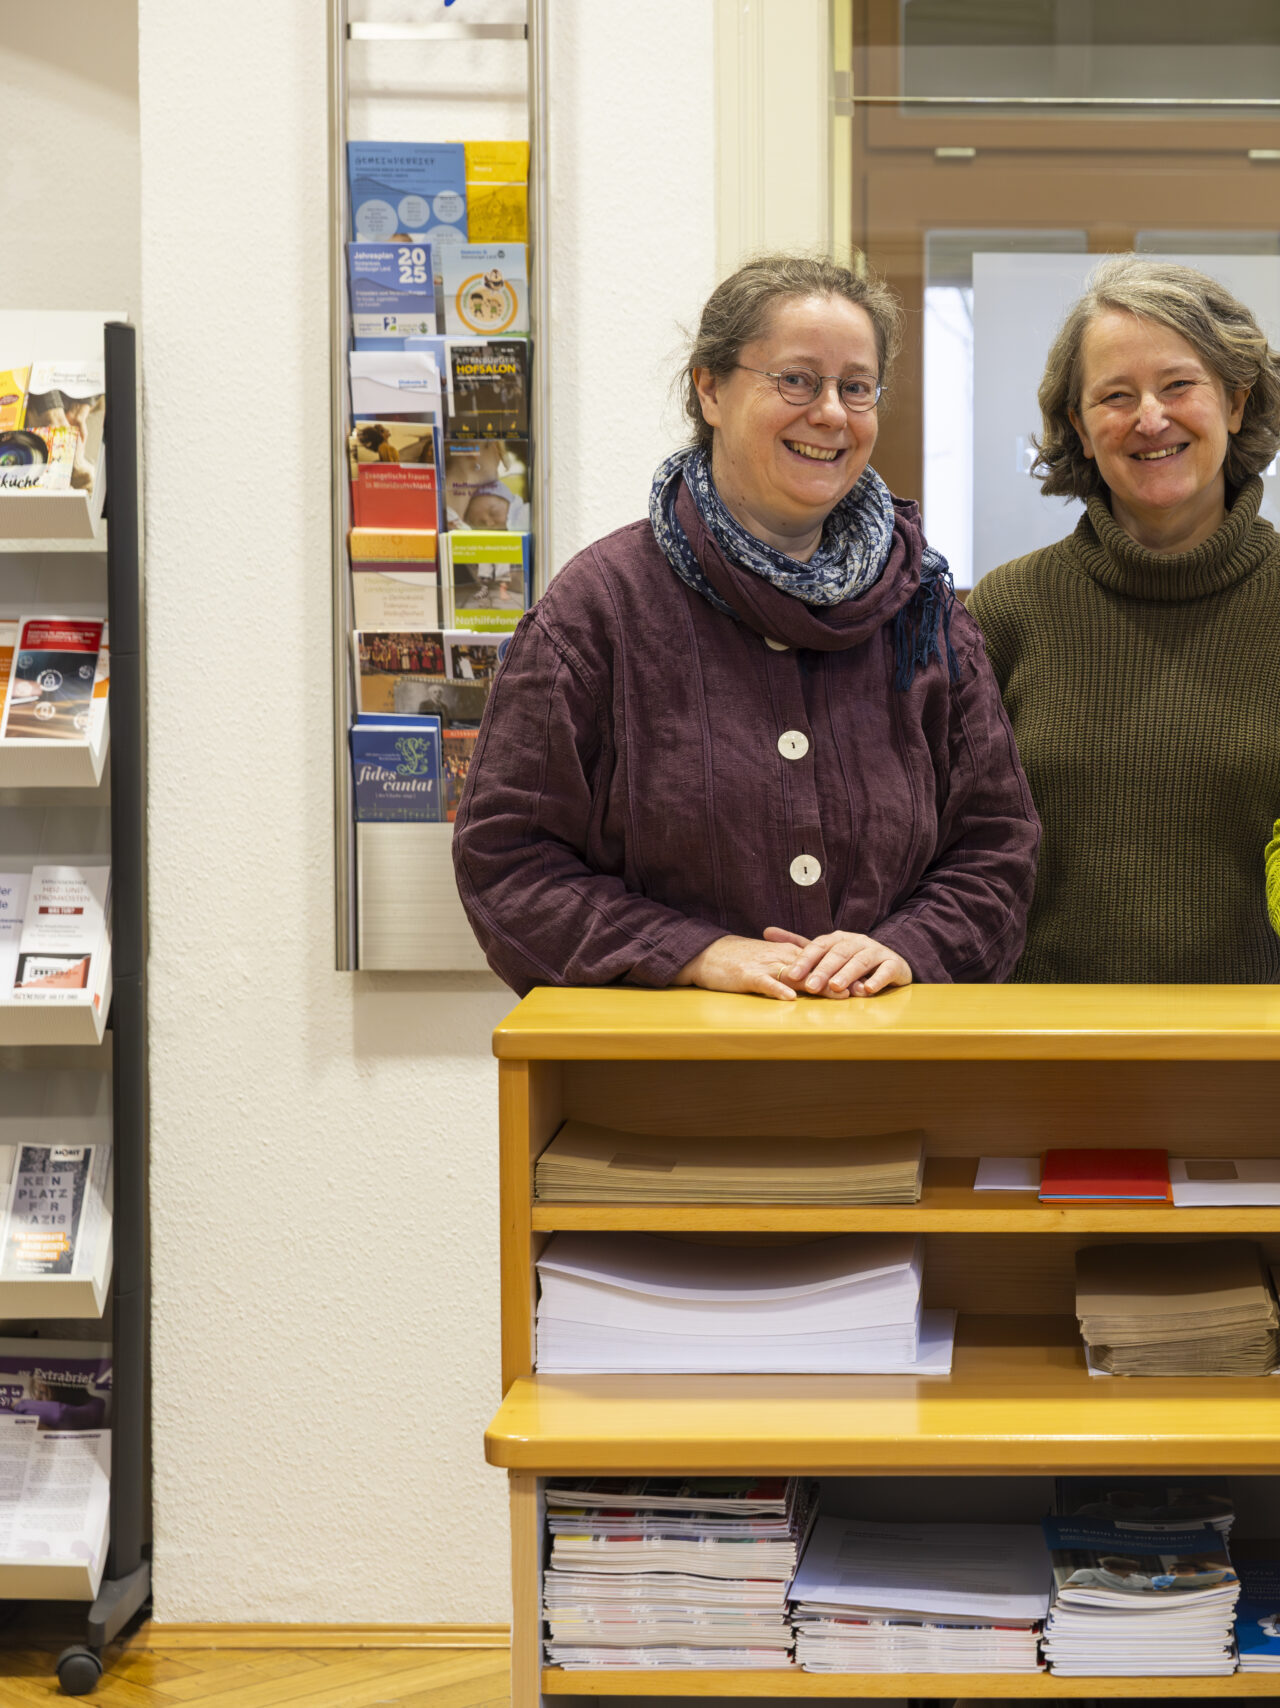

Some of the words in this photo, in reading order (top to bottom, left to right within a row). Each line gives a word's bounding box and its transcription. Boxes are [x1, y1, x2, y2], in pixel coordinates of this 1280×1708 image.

[354, 251, 394, 260] Jahresplan
[398, 248, 426, 266] 20
[399, 266, 427, 284] 25
[456, 364, 516, 375] HOFSALON
[0, 473, 39, 488] küche
[365, 472, 407, 481] Evangelische
[456, 616, 519, 625] Nothilfefond
[357, 766, 396, 785] fides
[383, 779, 433, 792] cantat
[23, 1176, 61, 1186] KEIN
[18, 1189, 68, 1199] PLATZ
[20, 1215, 66, 1225] NAZIS
[35, 1367, 94, 1384] Extrabrief
